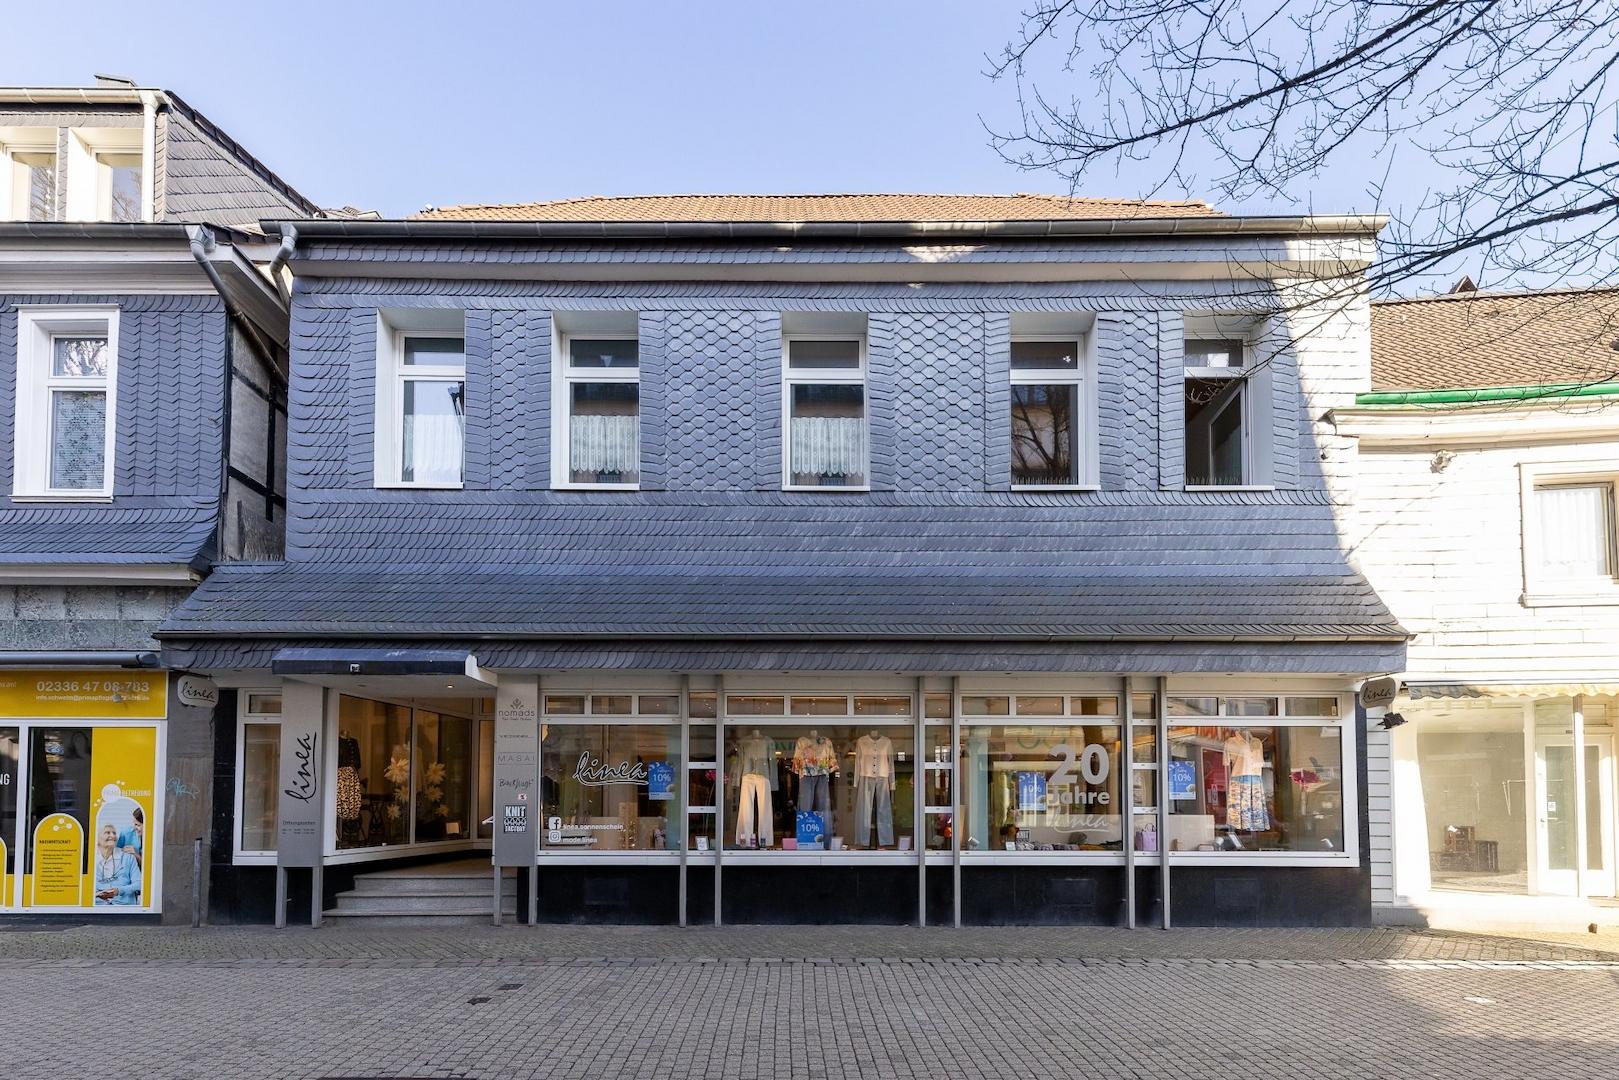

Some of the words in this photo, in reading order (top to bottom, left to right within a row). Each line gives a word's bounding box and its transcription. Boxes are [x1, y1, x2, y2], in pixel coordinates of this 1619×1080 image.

[36, 681, 80, 692] 02336
[82, 681, 100, 692] 47
[181, 681, 216, 703] linea
[1363, 685, 1395, 704] linea
[498, 709, 536, 717] nomads
[497, 754, 535, 762] MASAI
[1047, 743, 1110, 785] 20
[284, 731, 317, 805] linea
[572, 750, 649, 787] linea
[653, 773, 672, 782] 10%
[1172, 773, 1192, 782] 10%
[1047, 785, 1110, 807] Jahre
[505, 805, 526, 817] KNIT
[801, 823, 820, 832] 10%
